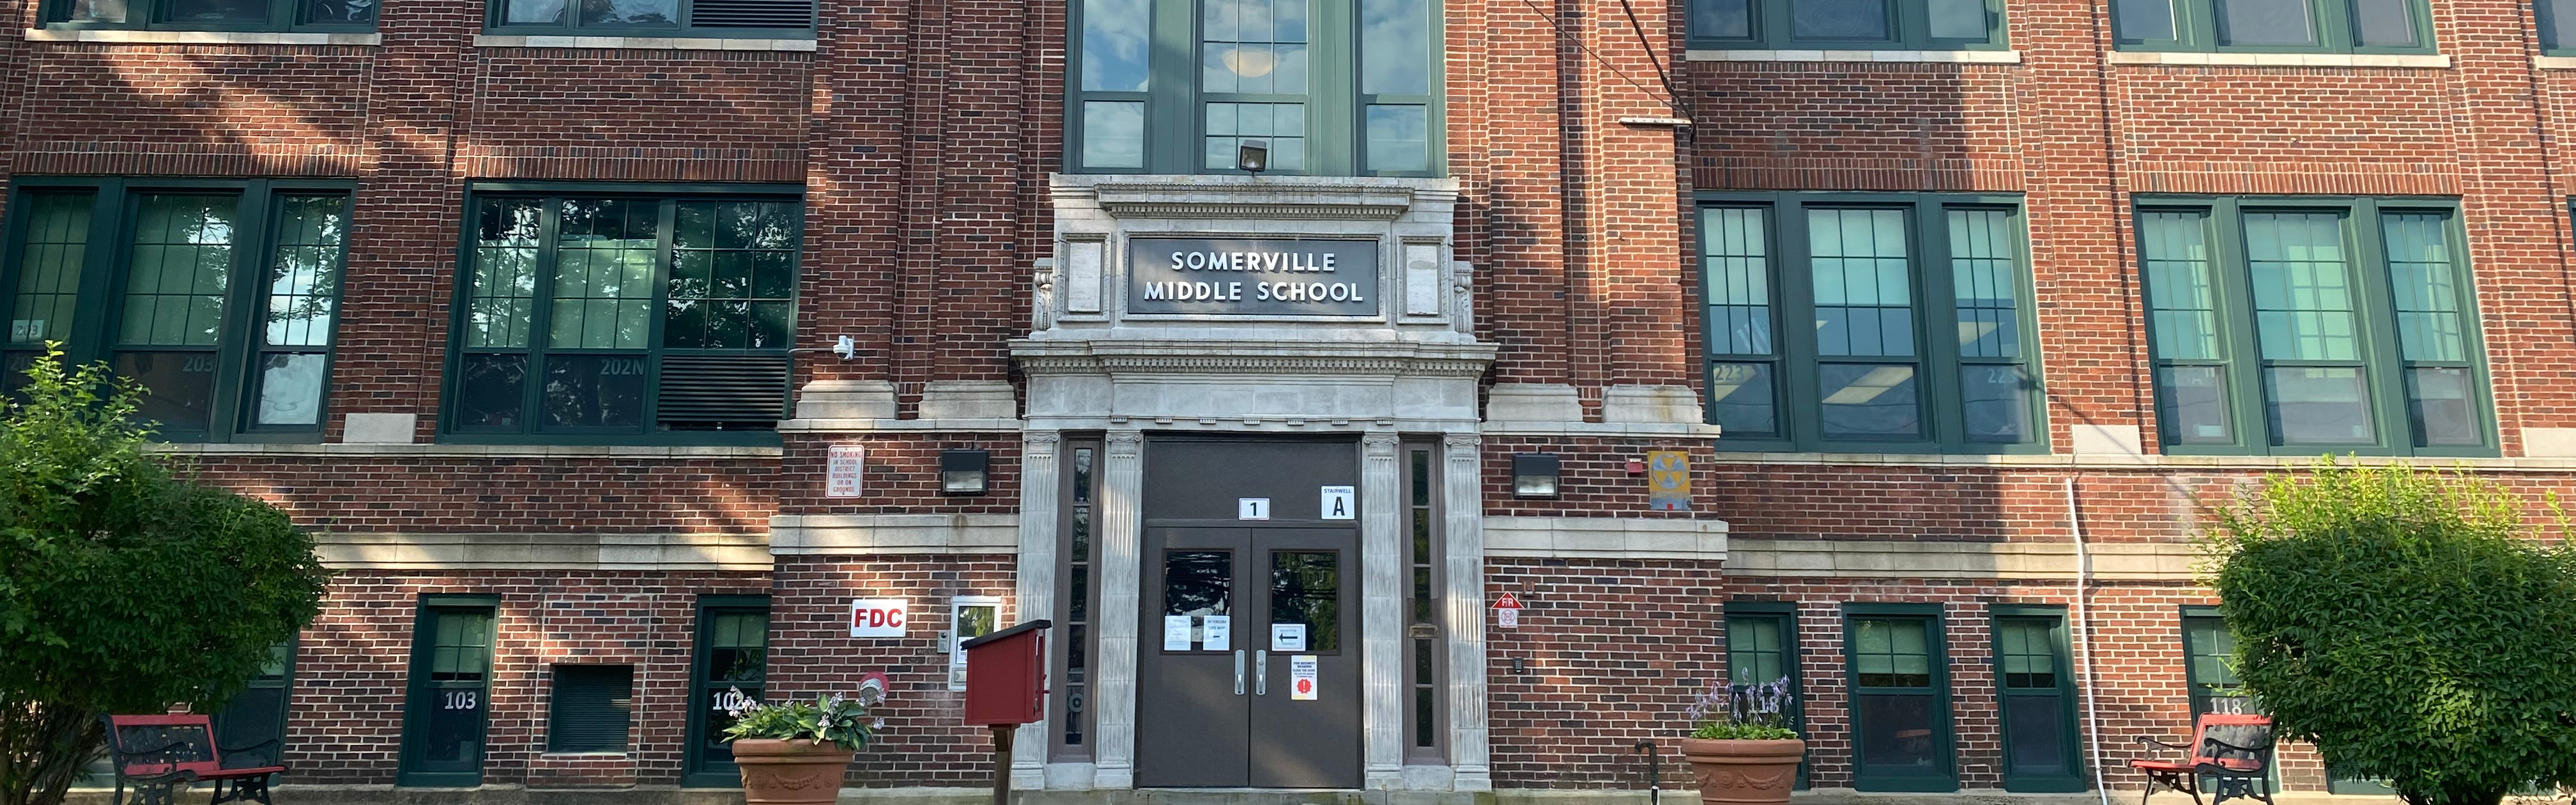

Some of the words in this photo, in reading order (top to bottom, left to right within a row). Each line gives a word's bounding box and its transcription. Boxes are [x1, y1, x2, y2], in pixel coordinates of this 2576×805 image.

[1172, 252, 1335, 272] SOMERVILLE
[1144, 281, 1241, 301] MIDDLE
[1257, 282, 1363, 302] SCHOOL
[15, 325, 38, 336] 203
[182, 356, 213, 372] 203
[601, 359, 645, 375] 202N
[1713, 365, 1744, 380] 223
[1250, 502, 1257, 516] 1
[1333, 496, 1345, 516] A
[854, 608, 903, 628] FDC
[445, 691, 476, 709] 103
[713, 692, 743, 710] 102
[2211, 698, 2242, 715] 118
